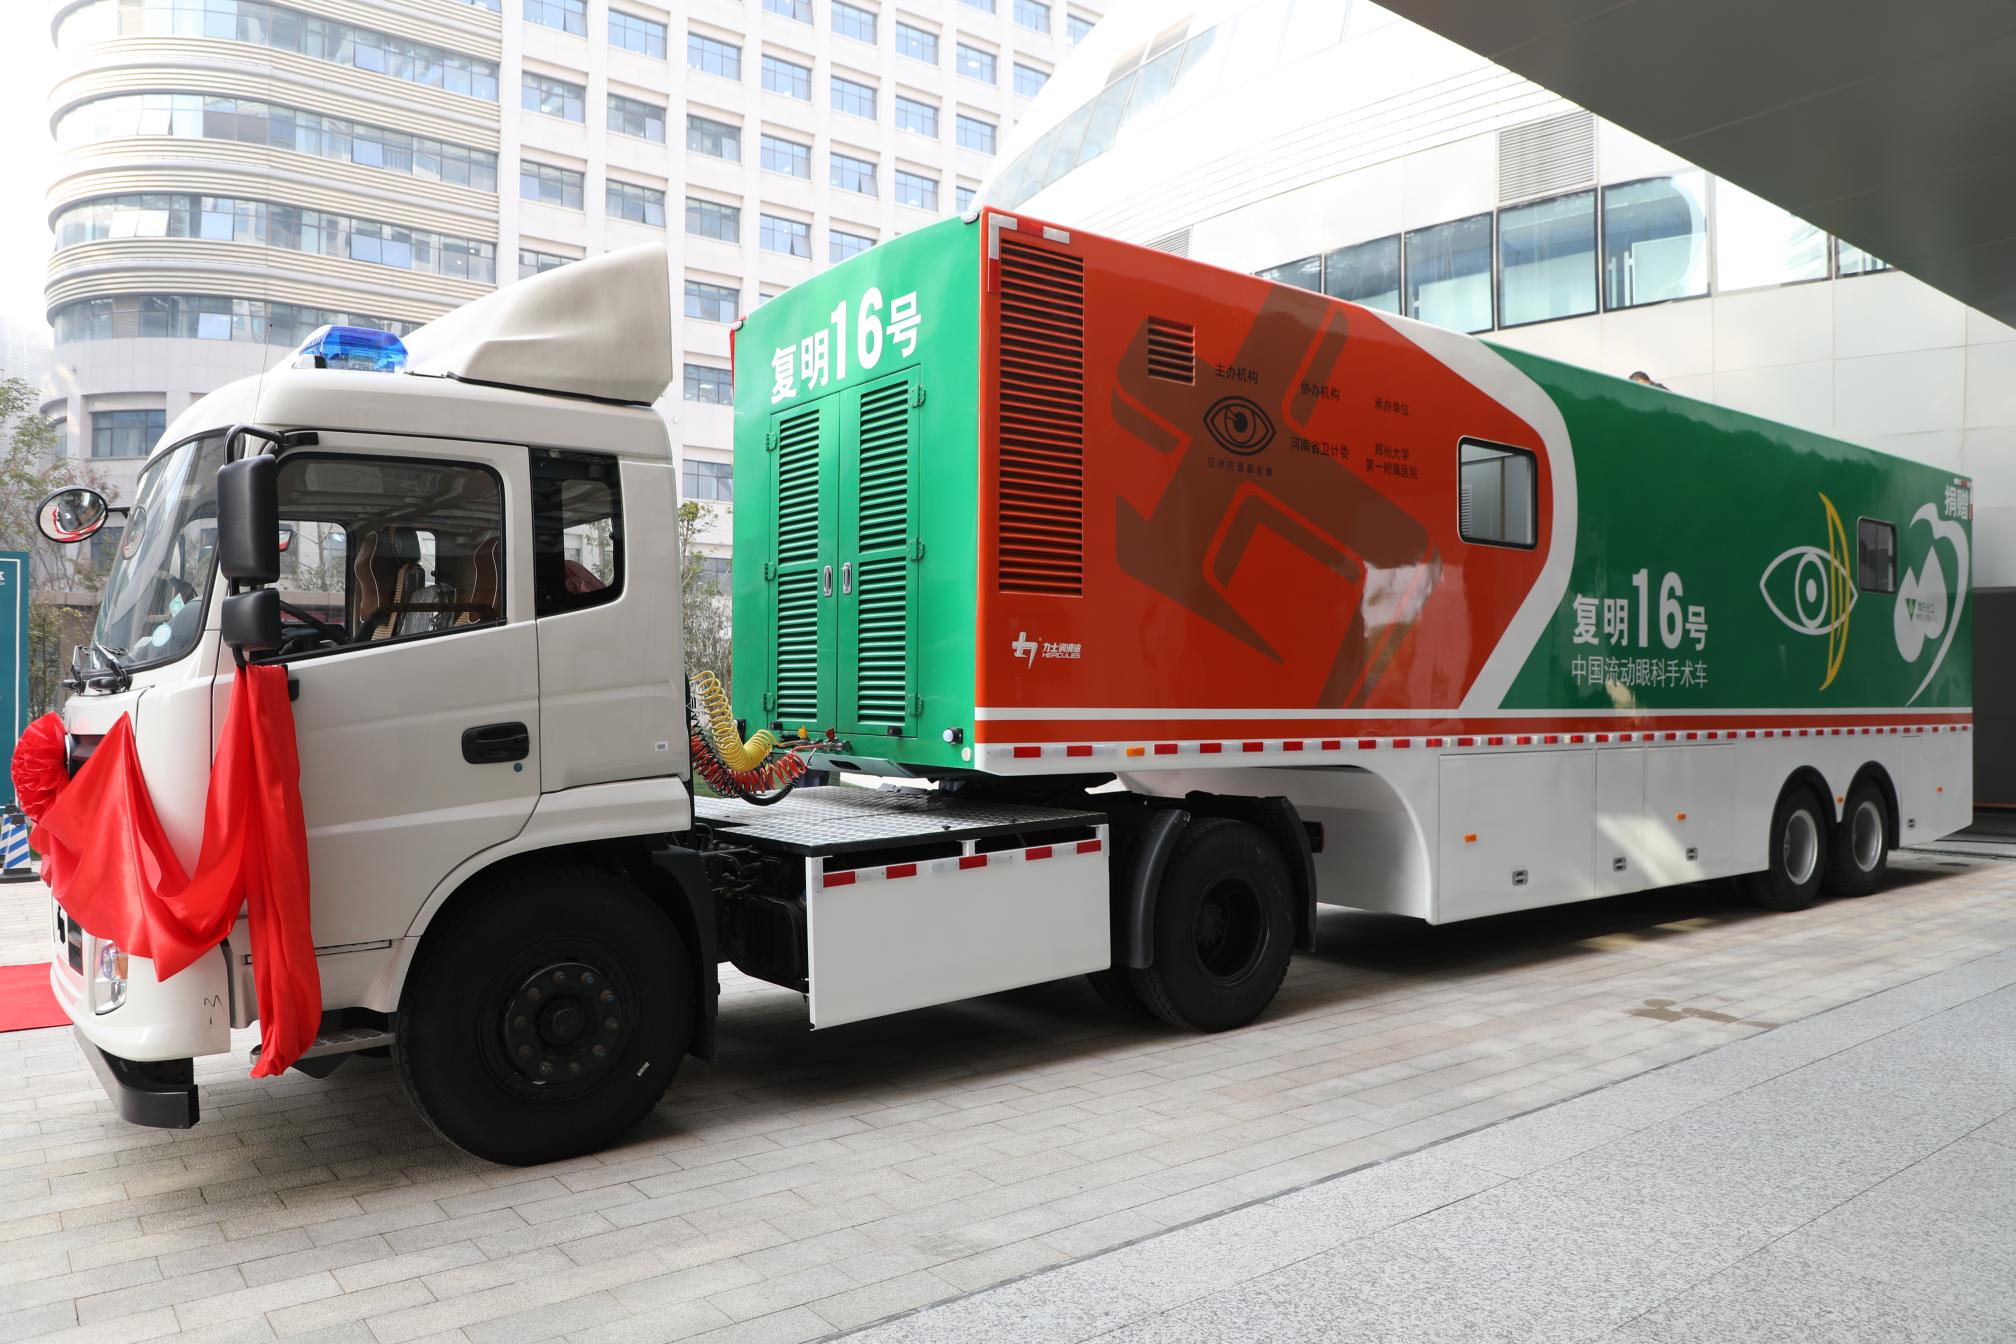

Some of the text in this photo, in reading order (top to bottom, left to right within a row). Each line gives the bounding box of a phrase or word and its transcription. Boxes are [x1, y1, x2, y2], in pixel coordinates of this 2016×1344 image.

[771, 286, 922, 405] 复明16号
[1215, 363, 1259, 384] 主办机构
[1300, 380, 1340, 401] 协办机构
[1374, 396, 1409, 416] 承办单位
[1290, 435, 1349, 460] 河南省卫计委
[1374, 442, 1409, 461] 郑州大学
[1366, 458, 1419, 480] 第一附属医院
[1944, 484, 1969, 520] 捐赠
[1572, 568, 1708, 651] 复明16号
[1571, 654, 1709, 689] 中国流动眼科手术车
